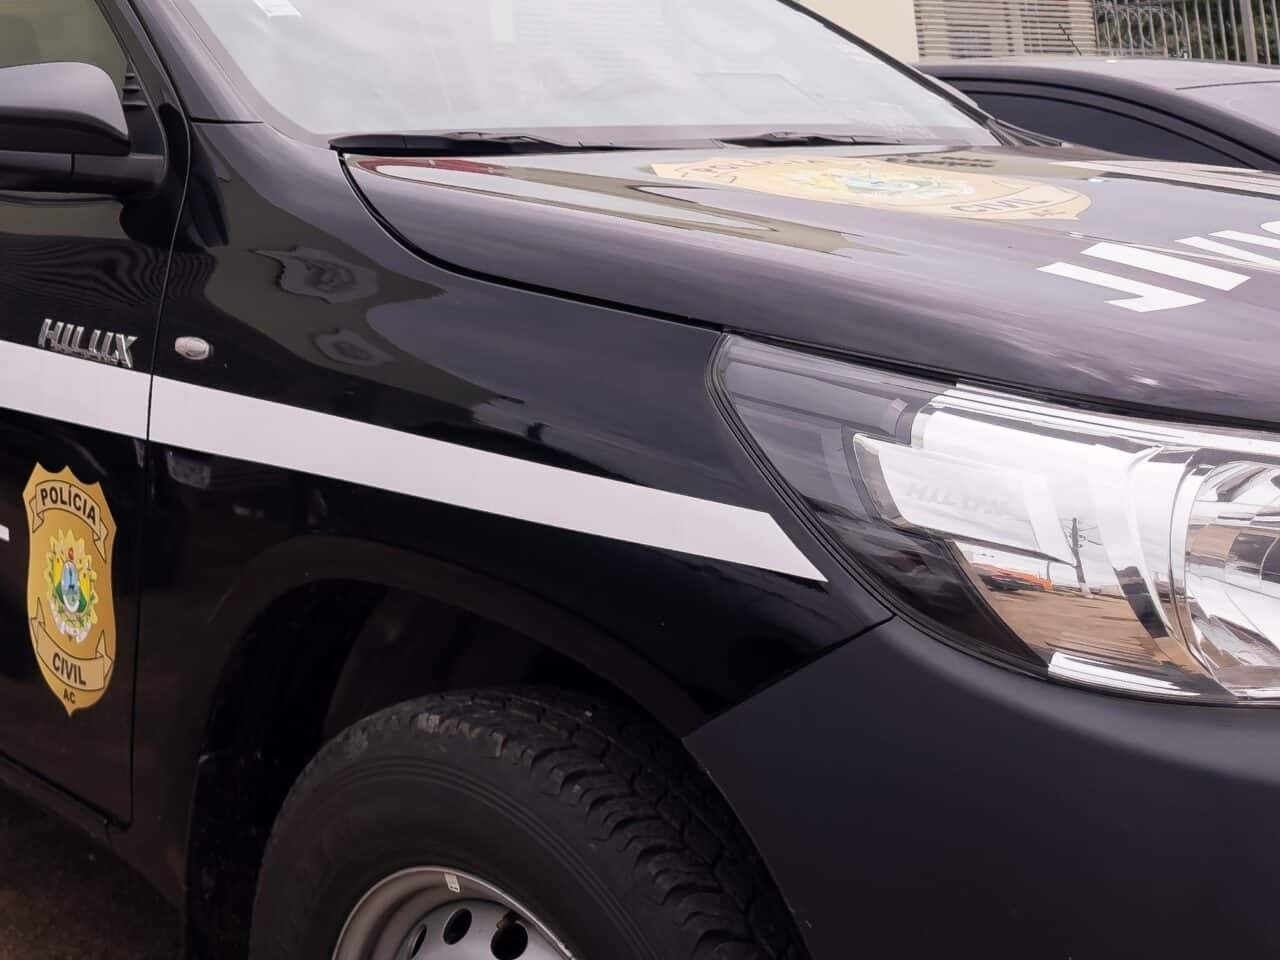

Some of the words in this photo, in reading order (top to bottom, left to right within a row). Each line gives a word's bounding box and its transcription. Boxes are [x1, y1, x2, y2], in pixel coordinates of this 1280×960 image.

[38, 318, 138, 368] HILUX
[40, 483, 96, 525] POLÍCIA
[52, 652, 87, 686] CIVIL
[63, 687, 76, 704] AC
